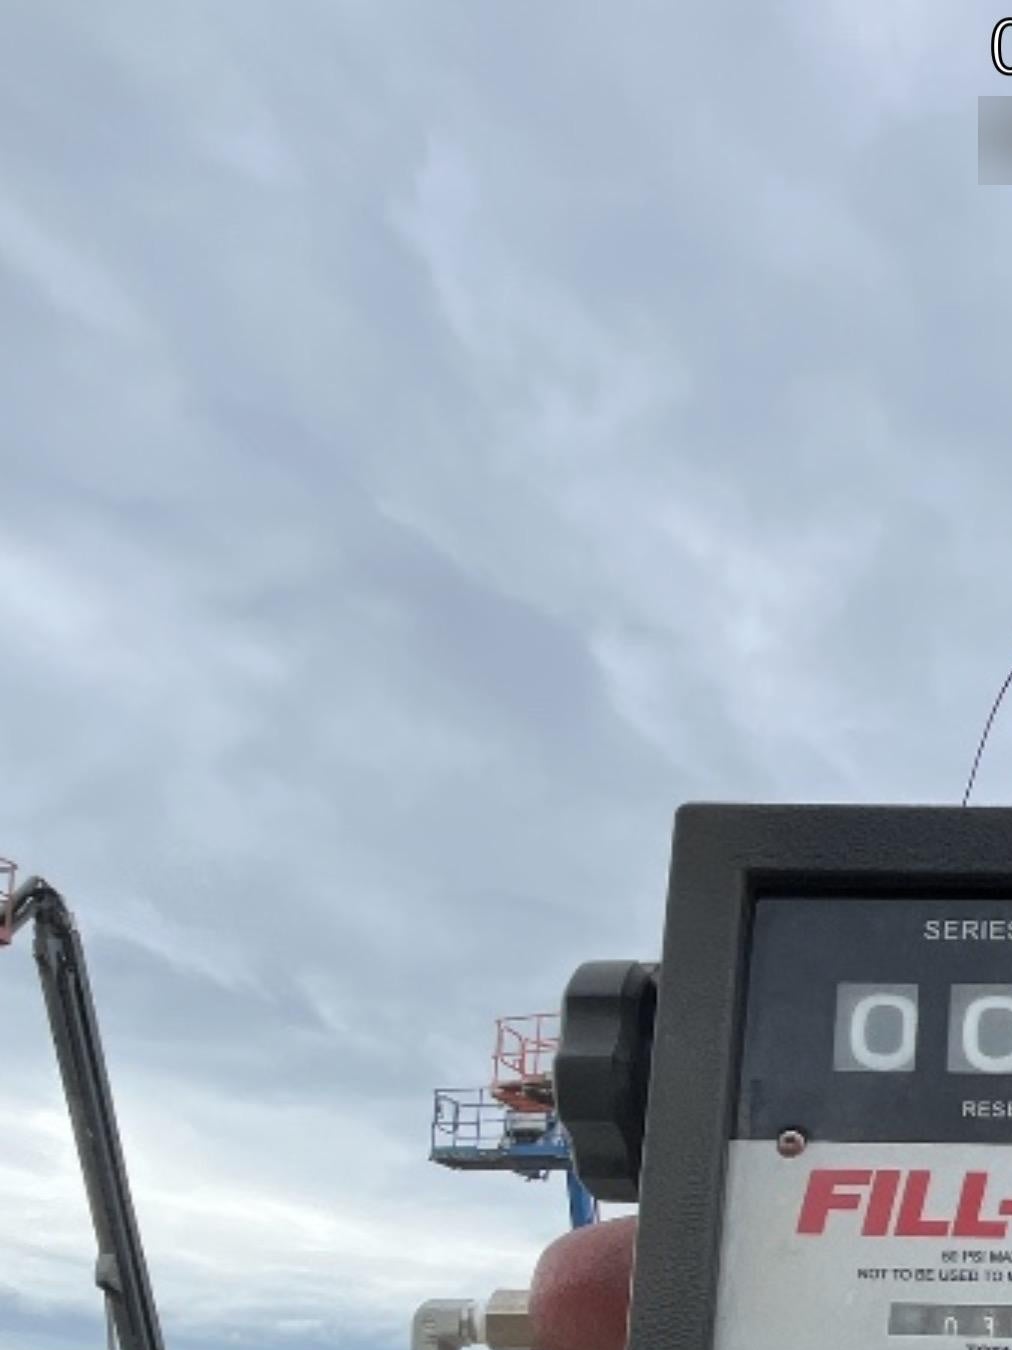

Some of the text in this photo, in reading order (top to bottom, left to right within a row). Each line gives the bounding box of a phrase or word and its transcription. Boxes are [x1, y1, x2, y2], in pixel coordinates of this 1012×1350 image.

[857, 1268, 887, 1280] NOT
[892, 1269, 912, 1281] TO
[914, 1269, 935, 1282] BE
[938, 1269, 979, 1283] USED
